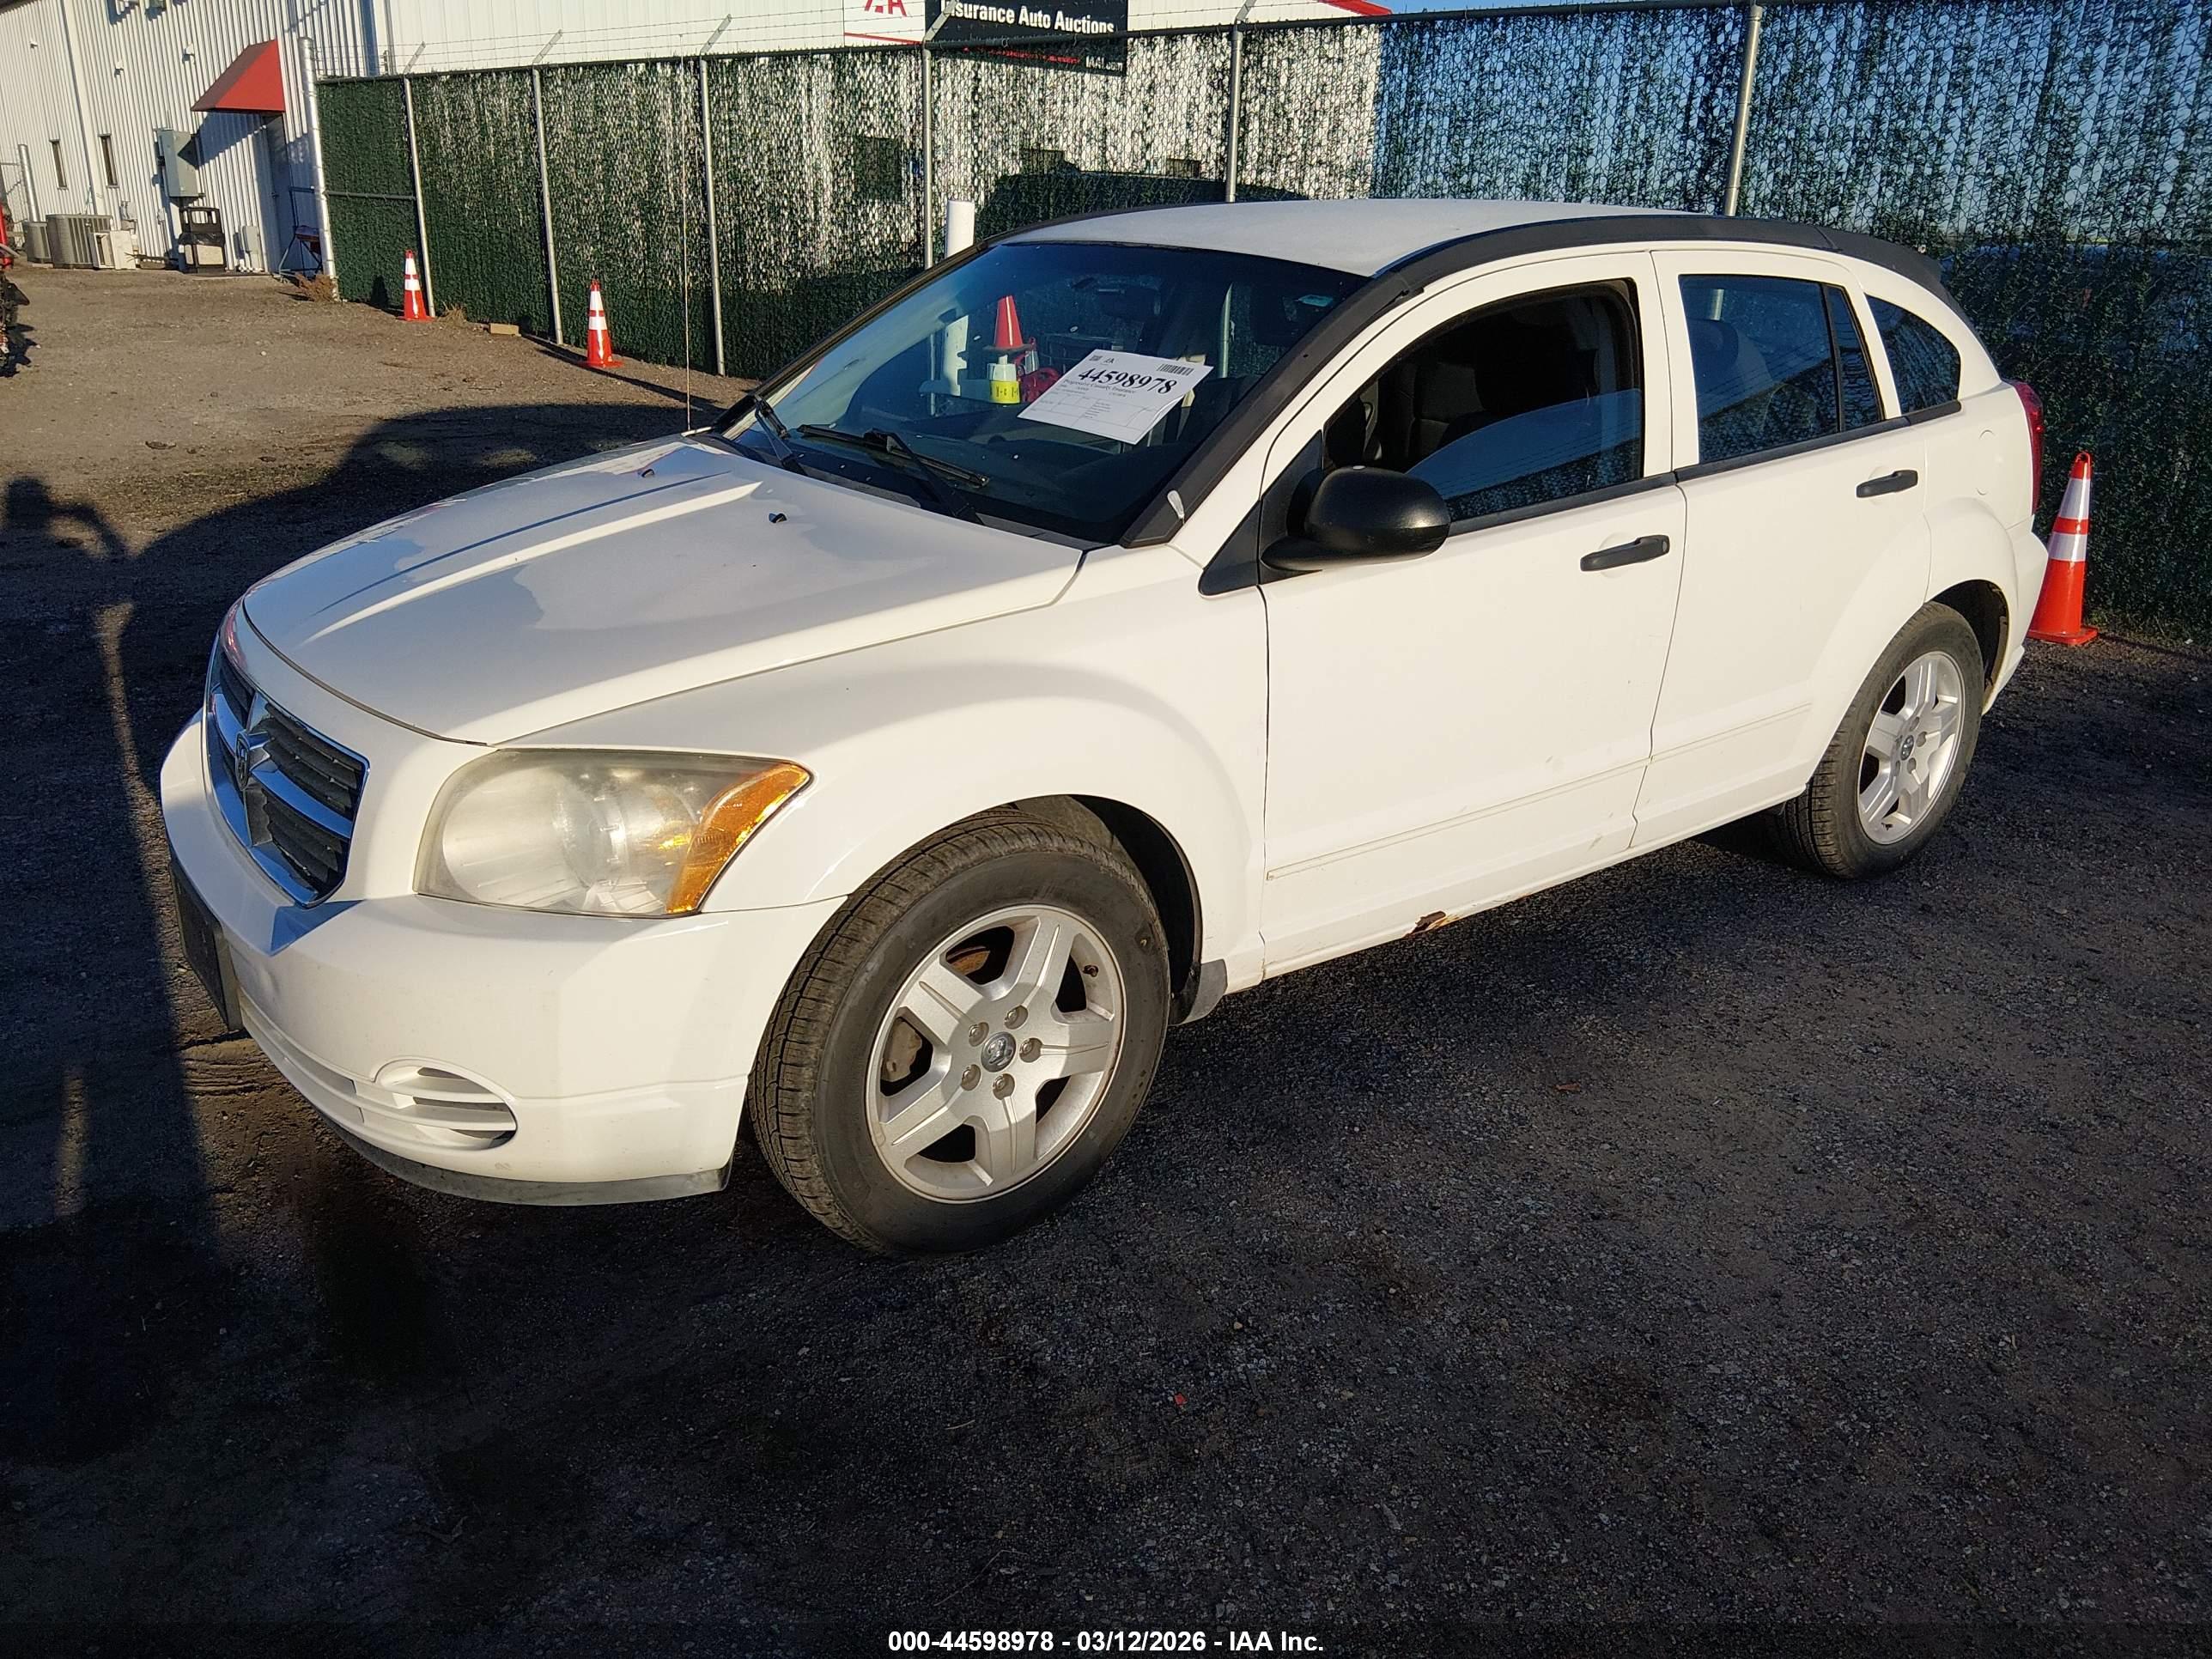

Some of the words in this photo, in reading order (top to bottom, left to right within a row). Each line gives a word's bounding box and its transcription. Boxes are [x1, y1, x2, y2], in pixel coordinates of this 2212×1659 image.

[1018, 5, 1051, 28] Auto
[1054, 10, 1115, 34] Auctions
[1079, 368, 1177, 394] 44598978
